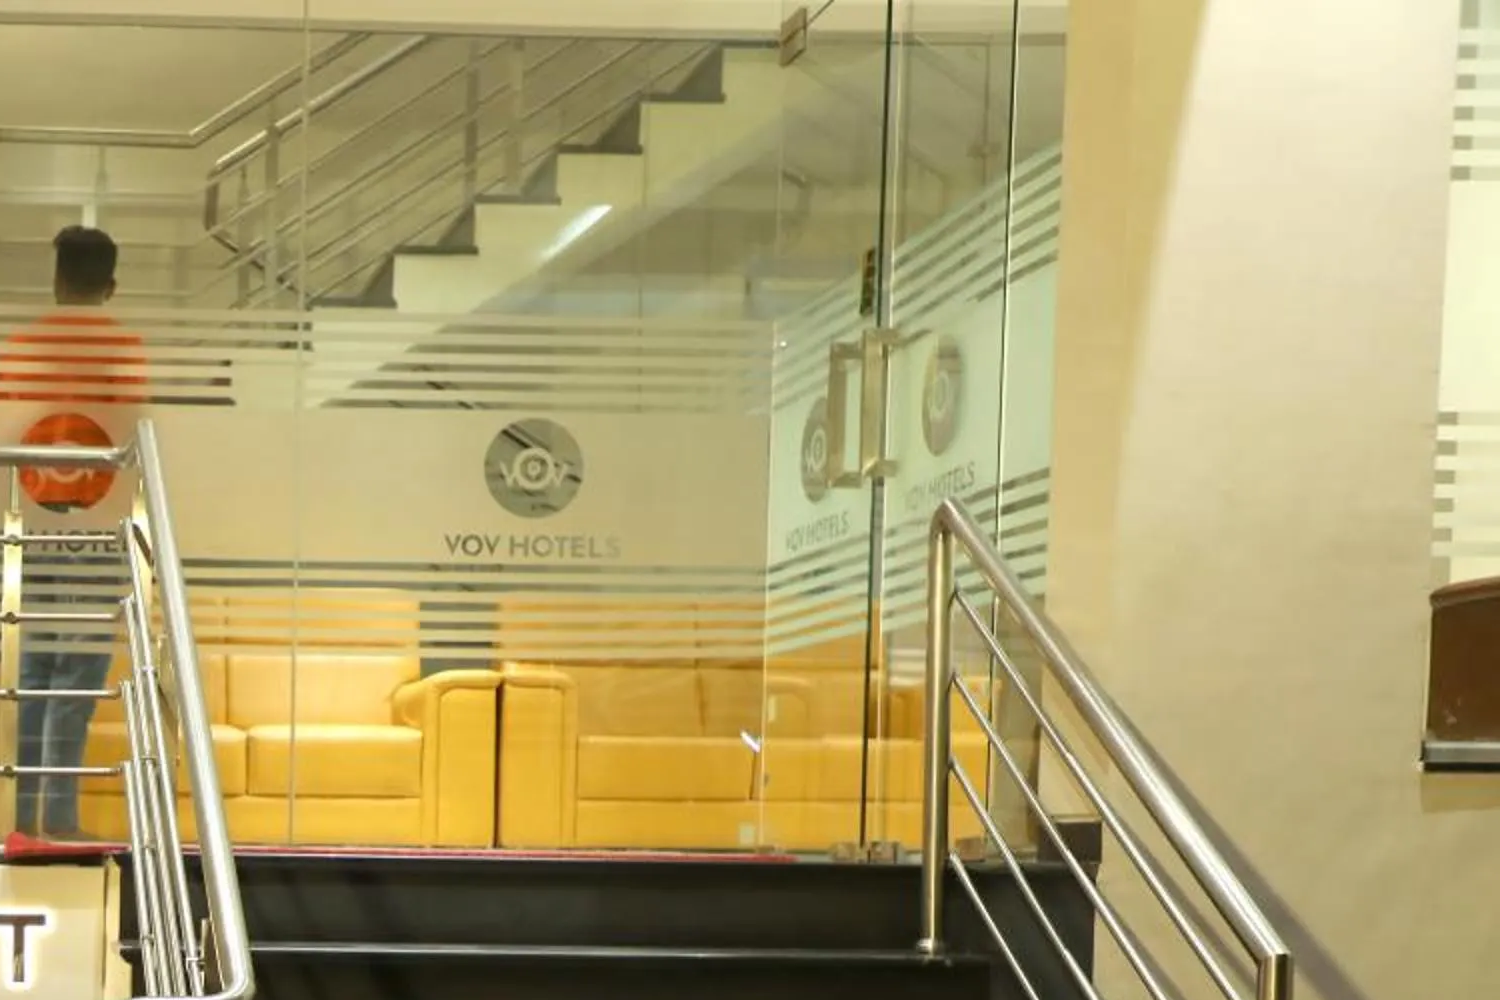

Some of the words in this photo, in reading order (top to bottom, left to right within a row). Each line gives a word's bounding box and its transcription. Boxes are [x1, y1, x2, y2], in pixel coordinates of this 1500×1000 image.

[500, 446, 568, 490] VOV
[40, 529, 128, 553] HOTE
[444, 534, 500, 557] VOV
[509, 534, 621, 559] HOTELS
